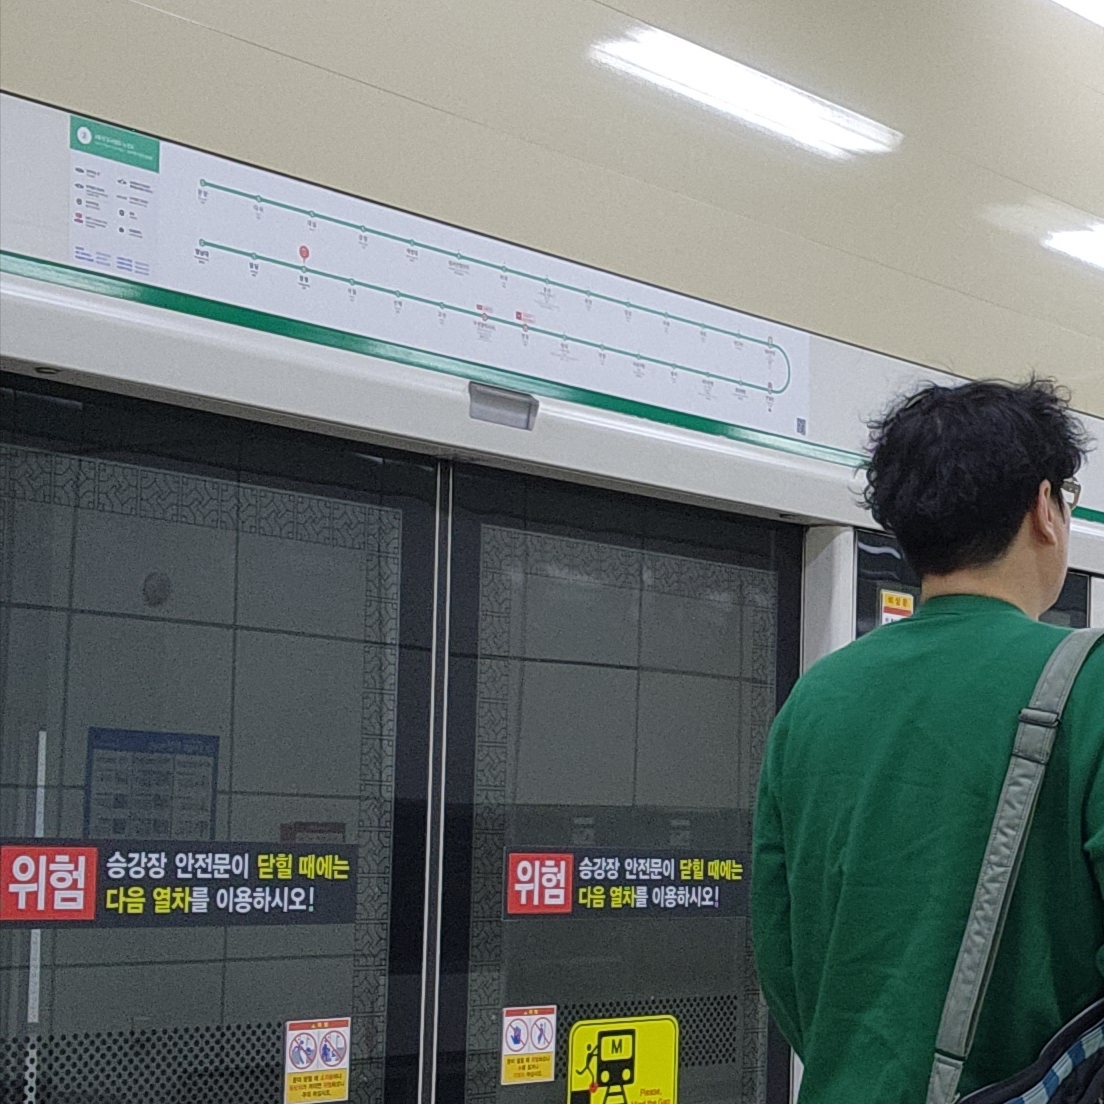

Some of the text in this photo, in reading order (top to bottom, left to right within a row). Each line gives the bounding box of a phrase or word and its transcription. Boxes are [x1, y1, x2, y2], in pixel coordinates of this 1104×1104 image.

[106, 851, 350, 880] 승강장 안전문이 닫힐 때에는
[578, 856, 744, 881] 승강장 안전문이 닫힐 때에는
[8, 854, 86, 911] 위험
[514, 860, 567, 906] 위험
[106, 886, 315, 914] 다음 열차를 이용하시오!
[578, 885, 719, 909] 다음 열차를 이용하시오!
[611, 1038, 623, 1054] M
